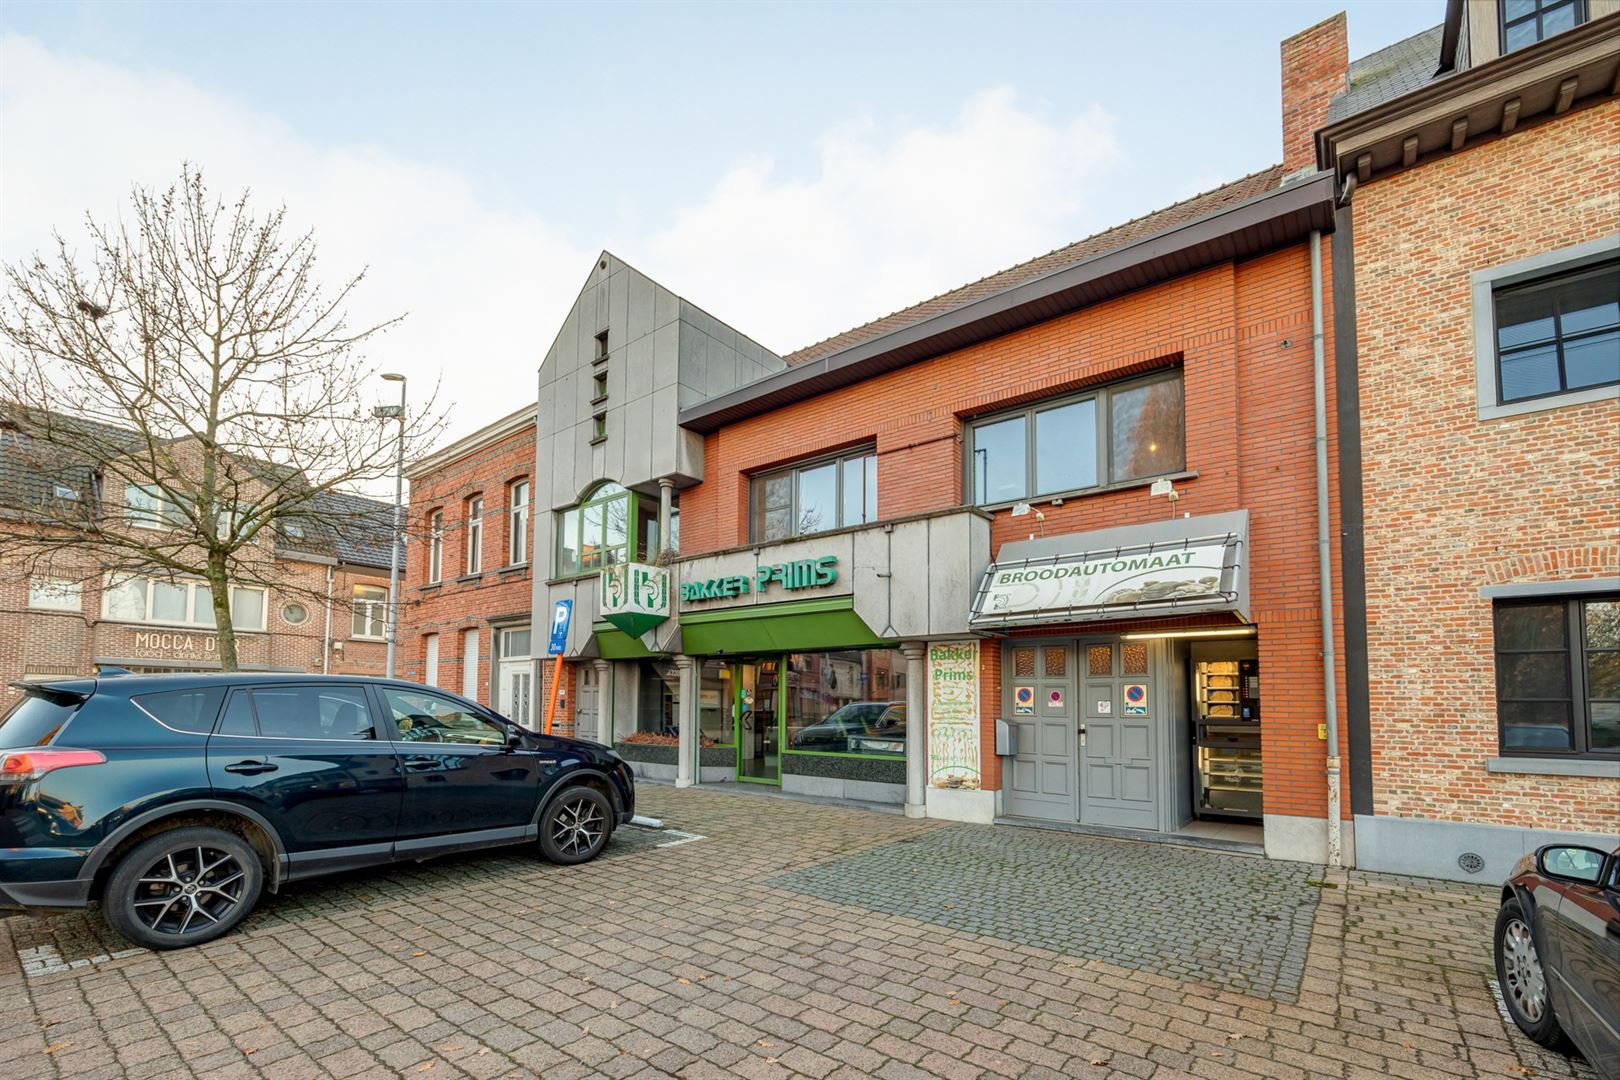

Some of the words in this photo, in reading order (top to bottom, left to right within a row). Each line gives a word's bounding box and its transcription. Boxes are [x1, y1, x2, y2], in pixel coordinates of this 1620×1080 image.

[680, 575, 749, 602] BAKKER
[757, 555, 838, 592] PRIMS
[1000, 552, 1196, 584] BROODAUTOMAAT
[553, 606, 567, 634] P
[135, 632, 193, 650] MOCCA
[205, 636, 240, 652] D'R
[930, 647, 977, 661] Bakker
[934, 668, 974, 681] Prims
